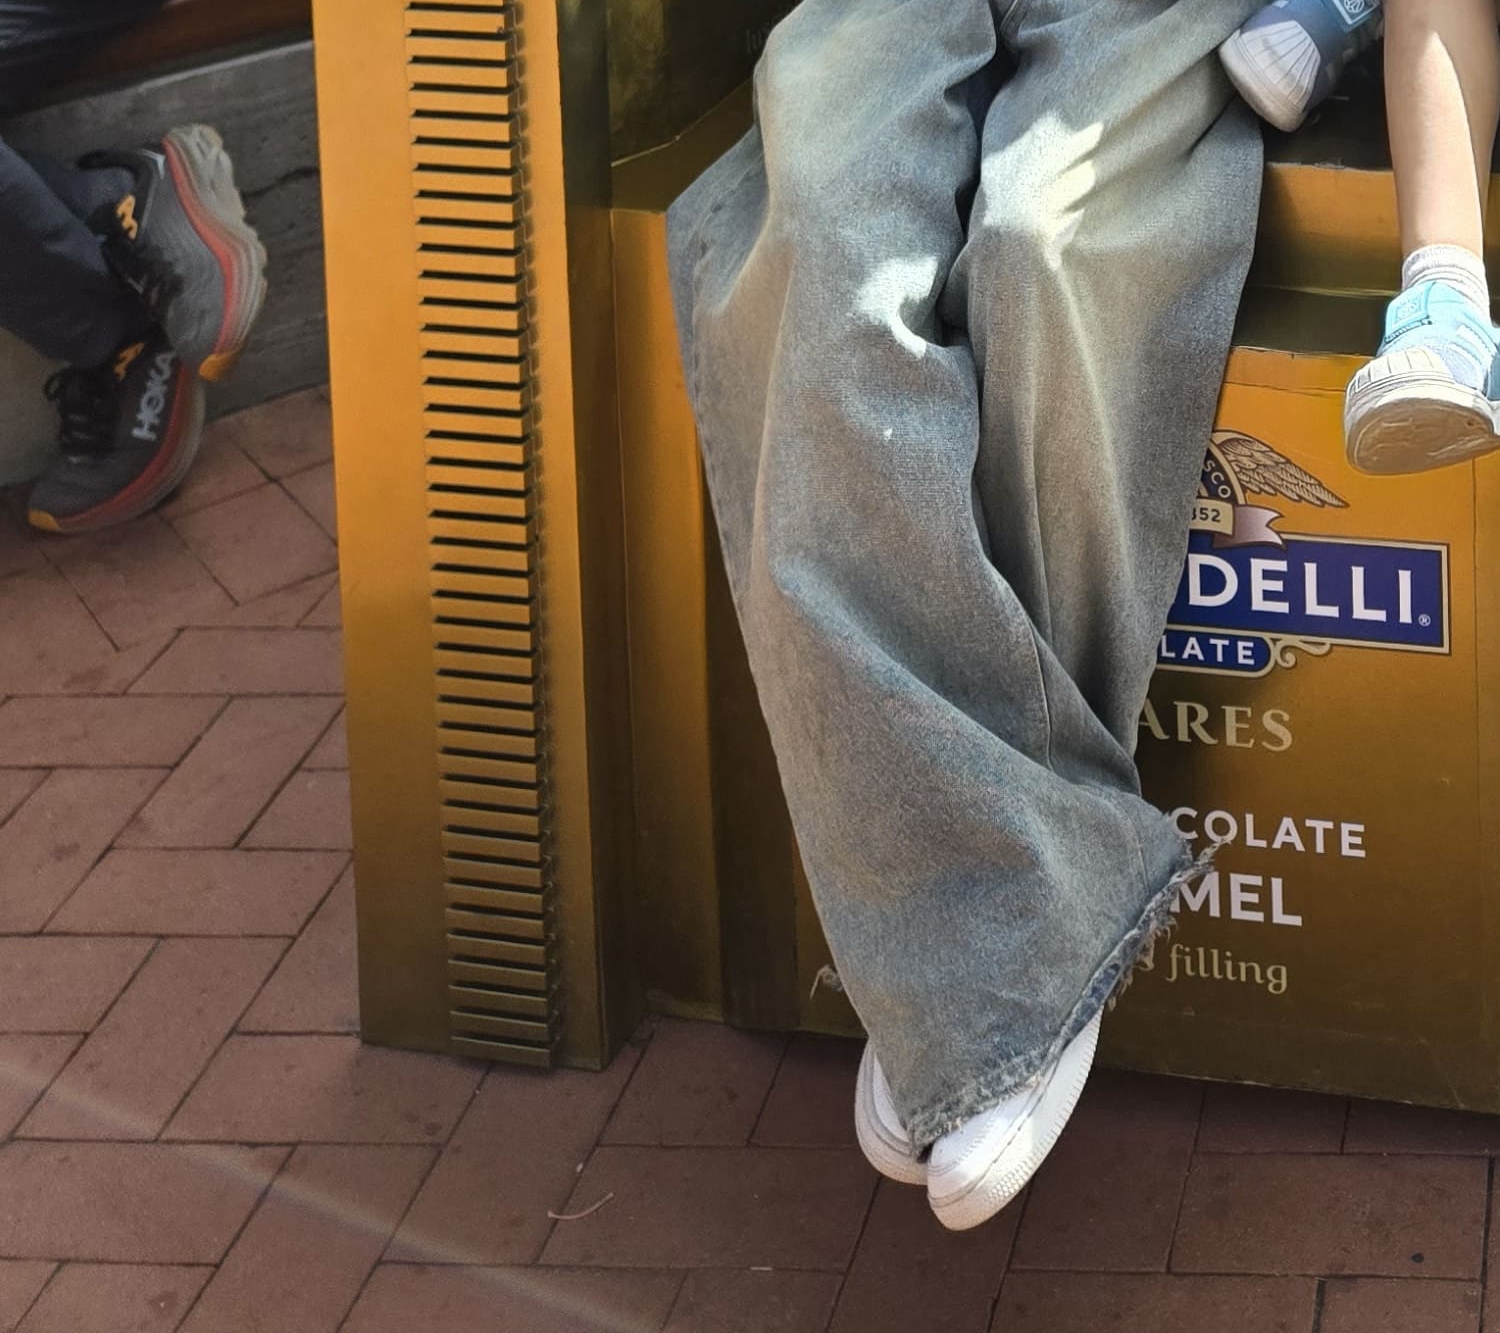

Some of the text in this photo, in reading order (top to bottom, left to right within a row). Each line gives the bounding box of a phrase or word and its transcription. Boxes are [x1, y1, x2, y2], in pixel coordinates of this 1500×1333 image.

[132, 352, 176, 441] HOKA
[1138, 698, 1293, 752] ARES
[1169, 806, 1366, 858] COLATE
[1165, 943, 1288, 995] filling
